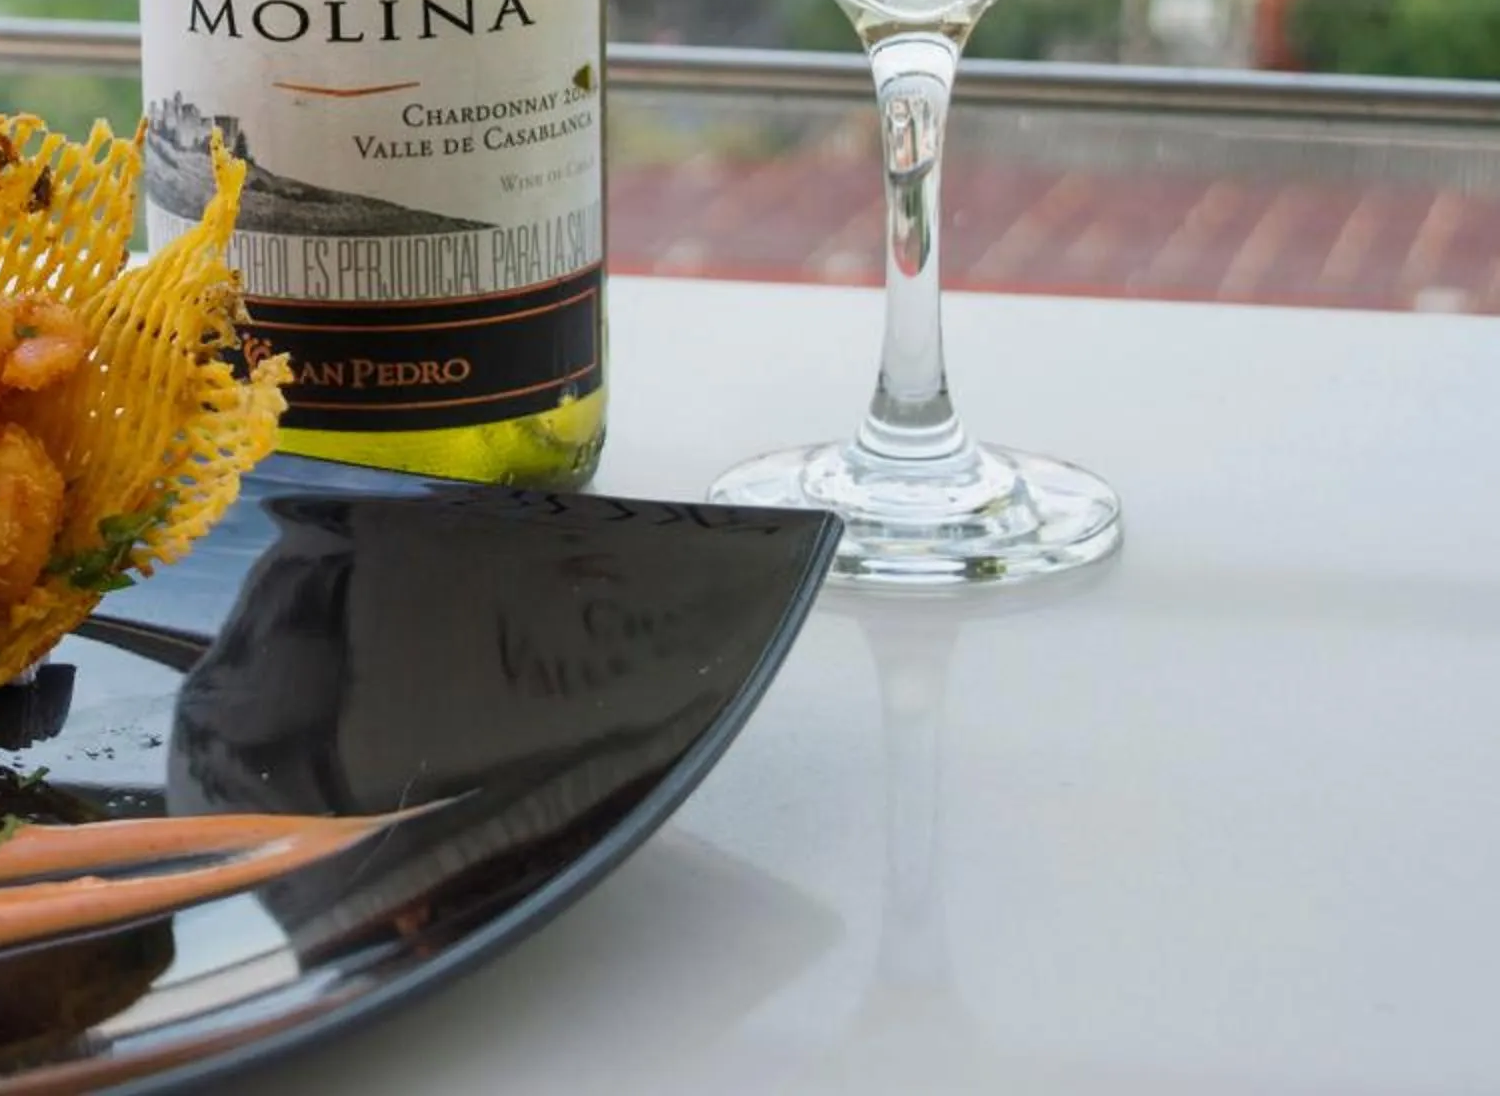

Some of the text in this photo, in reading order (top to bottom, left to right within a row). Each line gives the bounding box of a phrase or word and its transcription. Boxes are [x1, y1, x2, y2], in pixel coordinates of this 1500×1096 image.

[402, 91, 558, 128] CHARDONNAY
[353, 110, 593, 160] VALLE DE CASABLANCA
[302, 238, 330, 299] ES
[336, 233, 486, 300] PERJUDICIAL
[492, 222, 542, 291] PARA
[545, 215, 566, 278] LA
[300, 357, 471, 389] AN PEDRO
